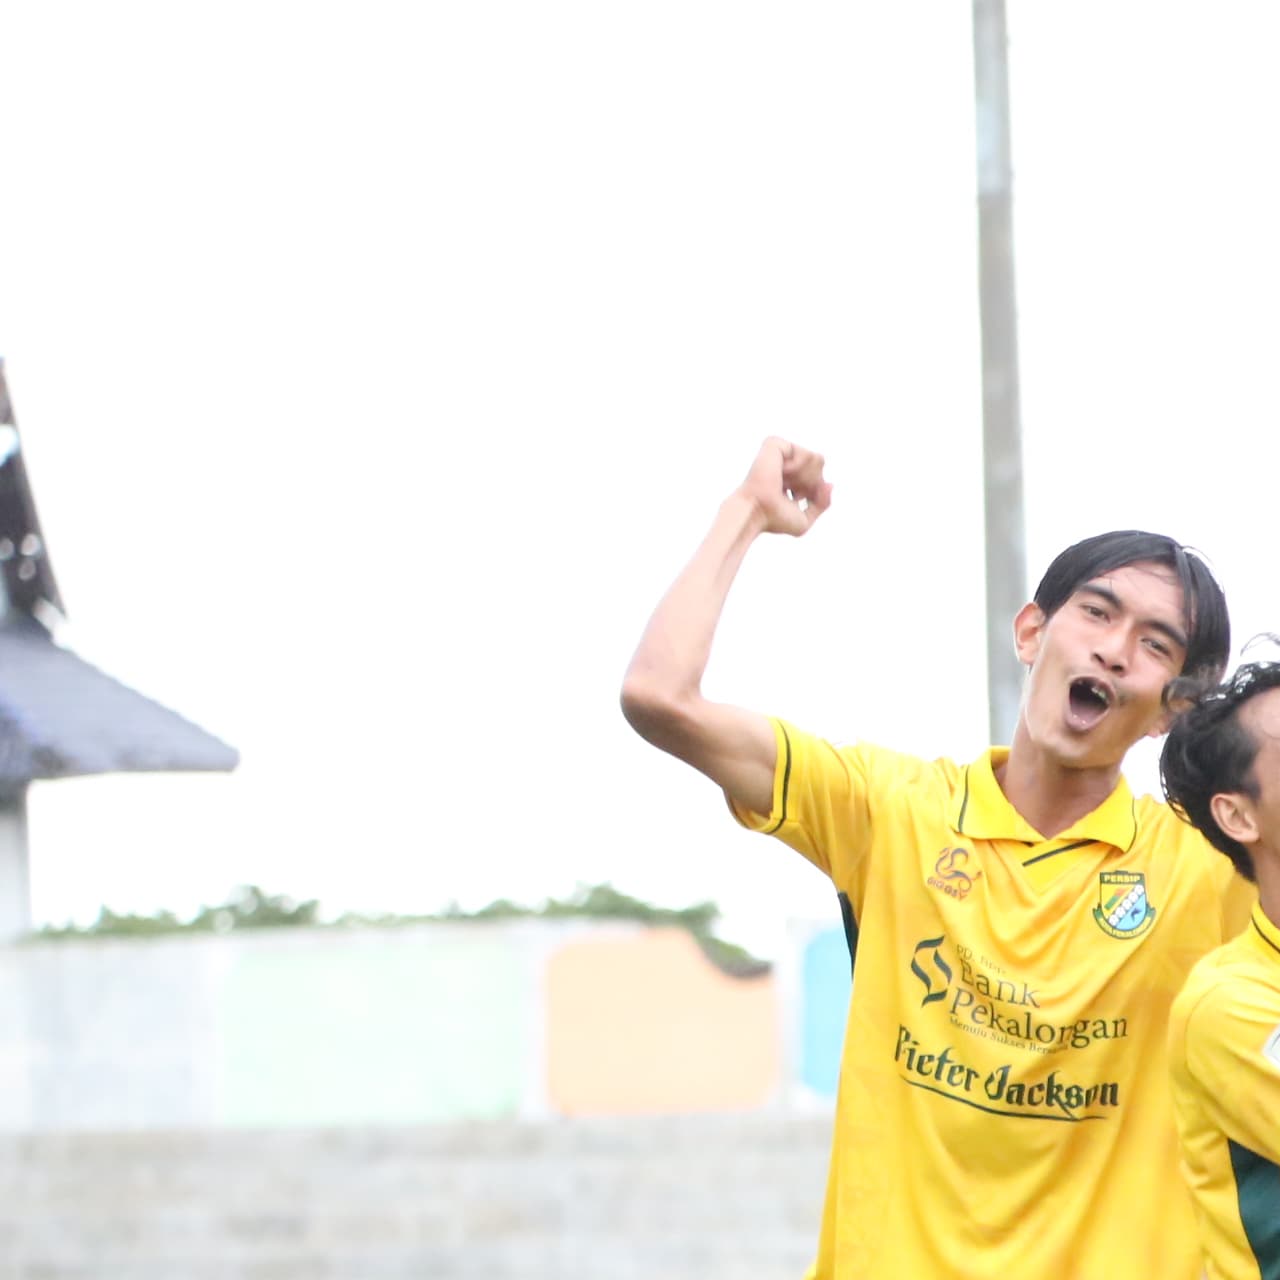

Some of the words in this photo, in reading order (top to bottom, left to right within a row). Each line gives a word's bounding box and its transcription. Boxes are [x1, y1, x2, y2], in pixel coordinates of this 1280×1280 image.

[1103, 874, 1141, 884] PERSIP
[949, 1015, 988, 1039] Menuju
[990, 1031, 1026, 1050] Sukses
[894, 1024, 980, 1092] Pieter
[984, 1063, 1120, 1114] Jackson
